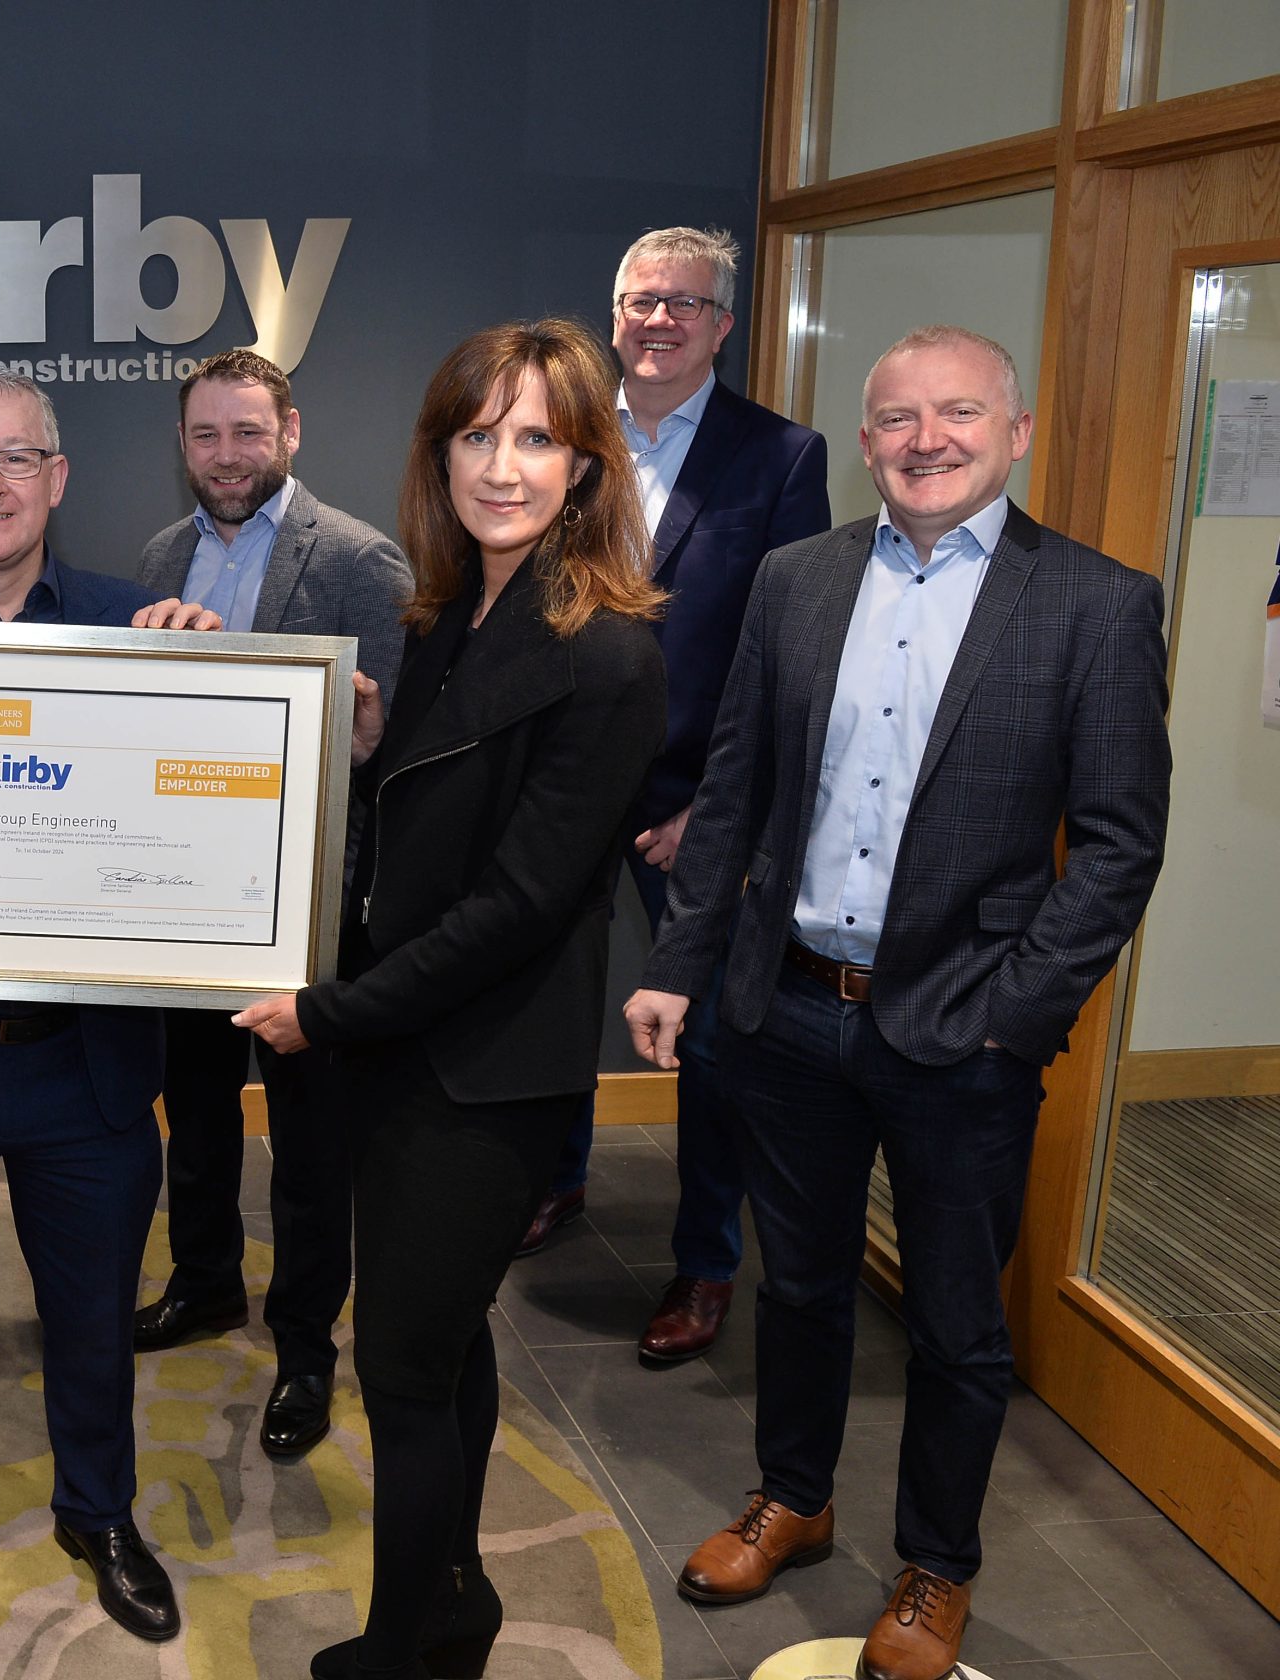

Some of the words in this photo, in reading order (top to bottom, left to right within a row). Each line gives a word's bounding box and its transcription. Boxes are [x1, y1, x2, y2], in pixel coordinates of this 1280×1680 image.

[160, 763, 186, 775] CPD
[190, 764, 271, 778] ACCREDITED
[159, 779, 227, 793] EMPLOYER
[31, 813, 117, 832] Engineering
